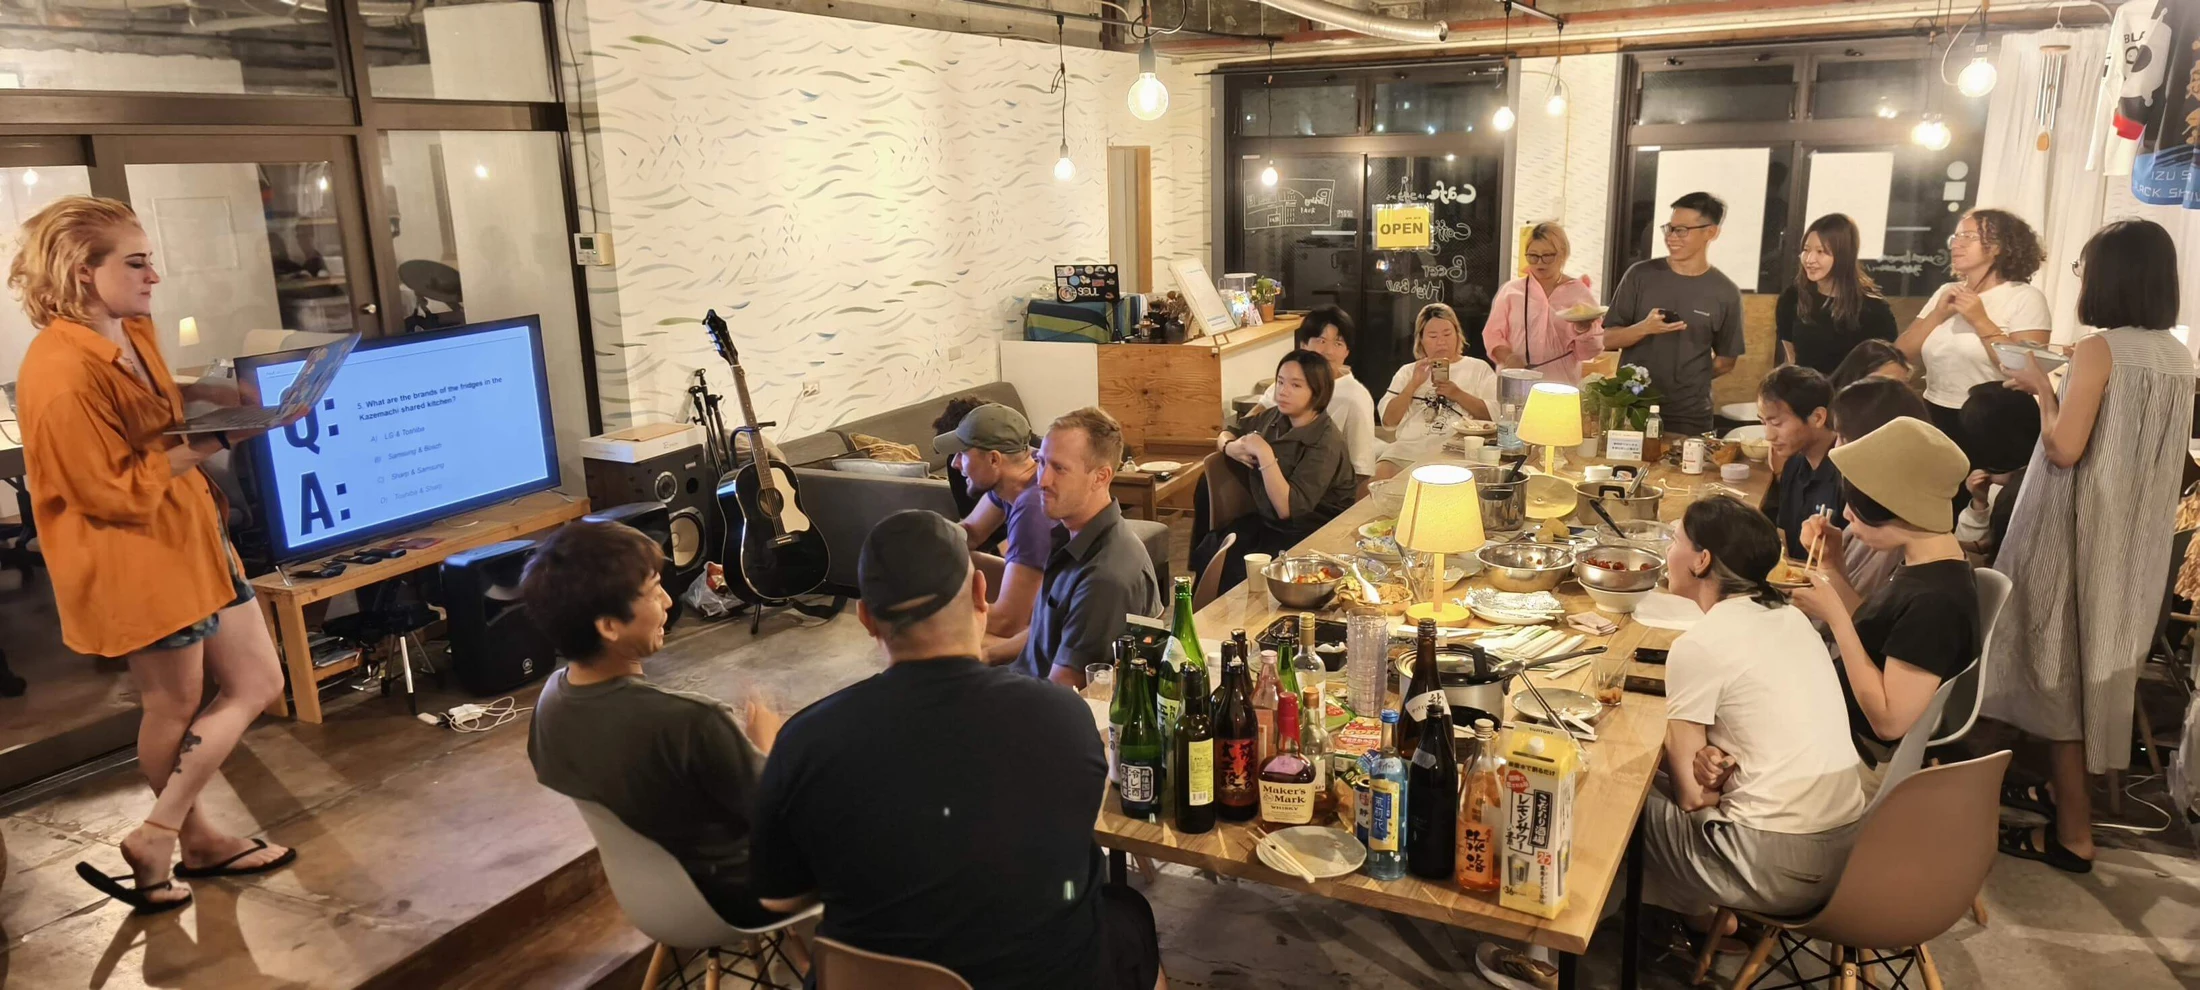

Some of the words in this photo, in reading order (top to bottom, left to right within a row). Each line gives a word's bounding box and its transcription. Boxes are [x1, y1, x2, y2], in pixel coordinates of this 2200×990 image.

[1380, 222, 1423, 235] OPEN
[1077, 286, 1100, 297] SOUL
[366, 399, 386, 408] What
[386, 396, 399, 404] are
[399, 394, 412, 402] the
[413, 389, 438, 399] brands
[439, 386, 447, 394] of
[447, 384, 459, 393] the
[460, 380, 483, 390] fridges
[359, 408, 400, 421] Kazemachi
[401, 402, 426, 413] shared
[427, 395, 457, 408] kitchen?
[384, 432, 394, 440] LG
[301, 471, 351, 536] A:
[1263, 784, 1306, 795] Maker's
[1274, 794, 1306, 804] Mark
[1515, 794, 1531, 850] レモンサワー
